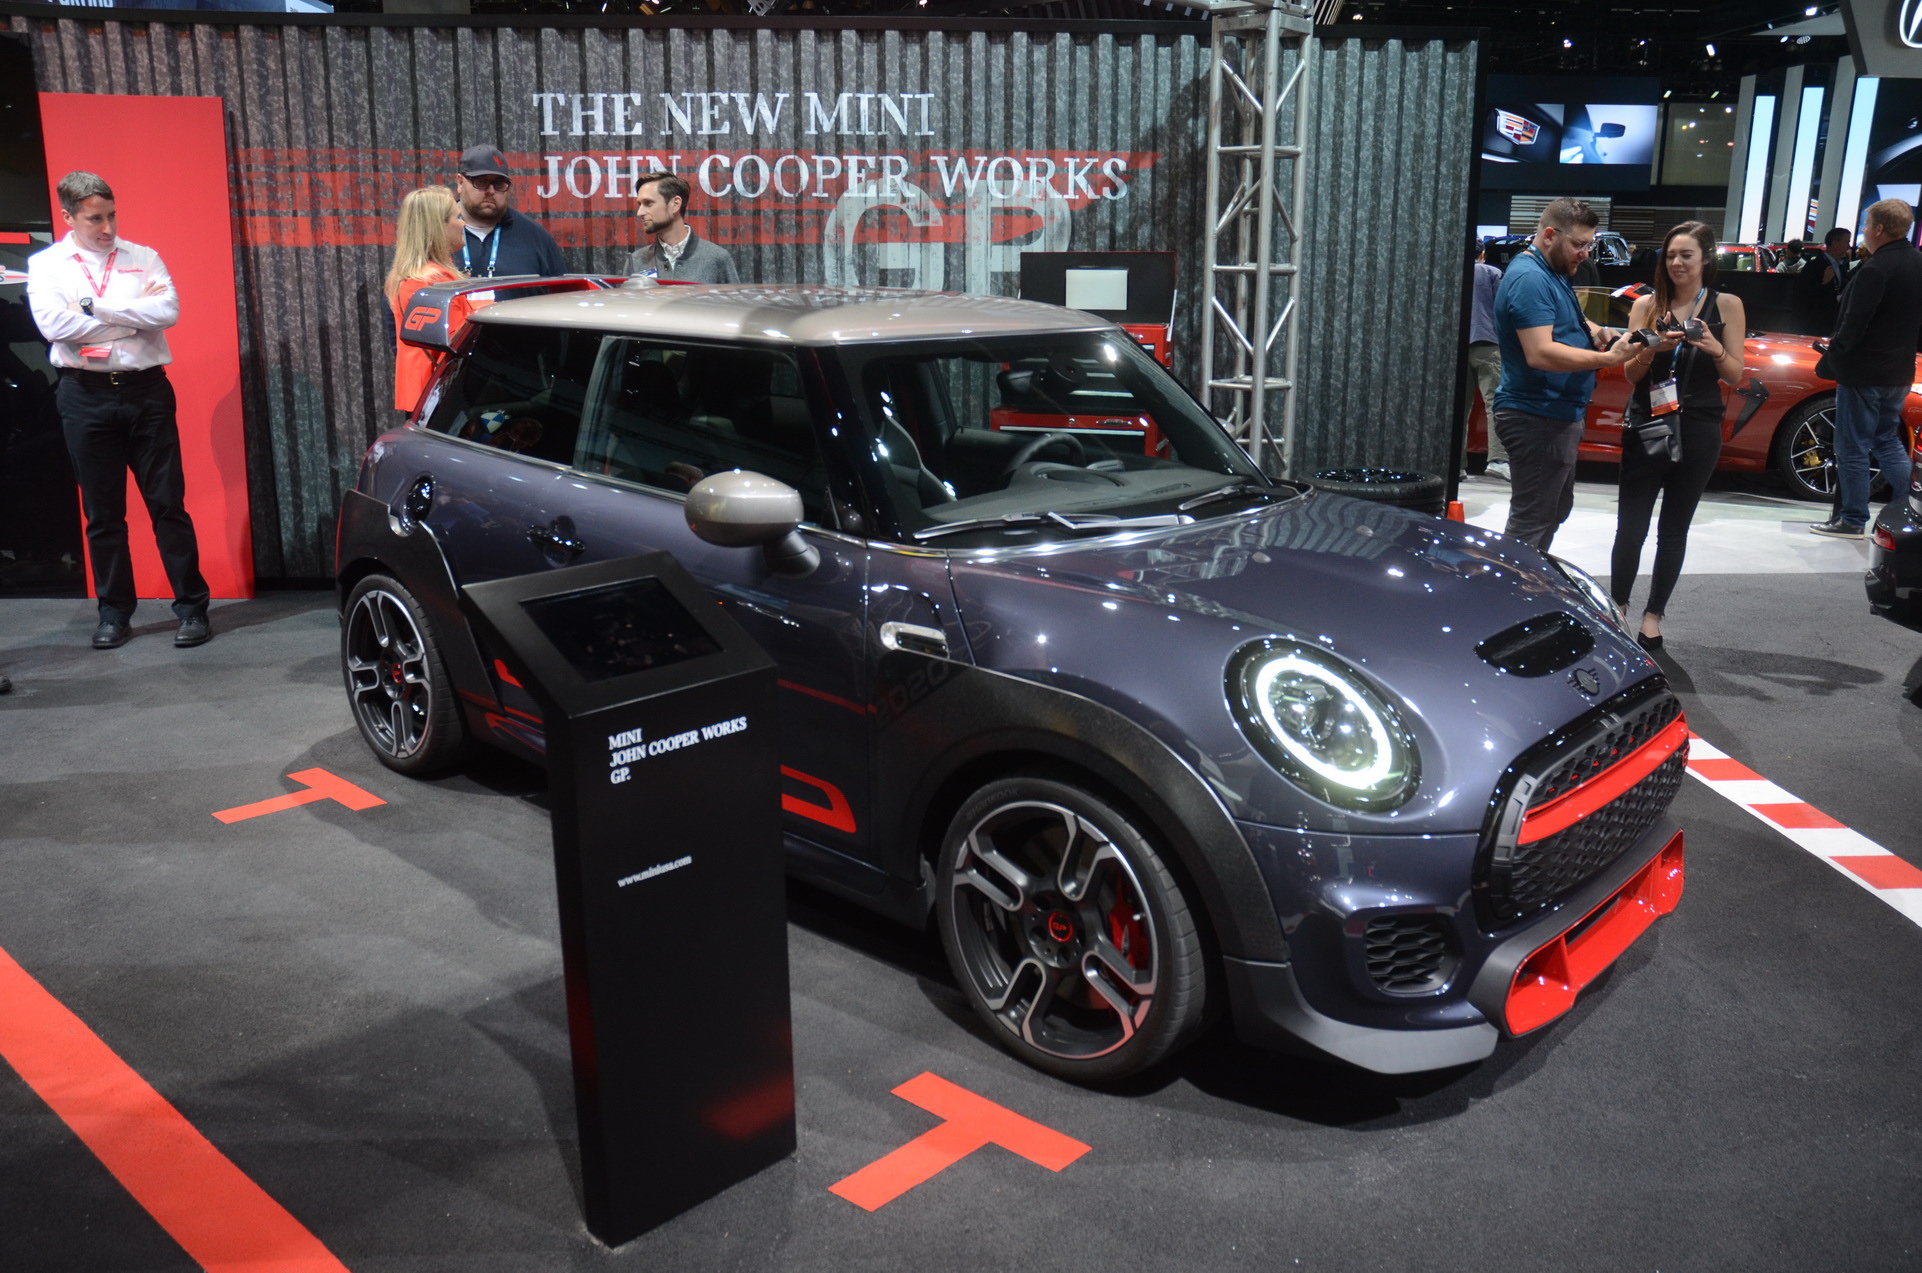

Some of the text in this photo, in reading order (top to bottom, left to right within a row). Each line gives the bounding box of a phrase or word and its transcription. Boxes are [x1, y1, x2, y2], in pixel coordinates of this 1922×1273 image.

[533, 92, 935, 136] THE NEW MINI
[699, 154, 916, 199] COOPER
[930, 155, 1130, 201] WORKS
[404, 306, 442, 332] GP
[608, 728, 643, 751] MINI
[609, 716, 748, 768] JOHN COOPER WORKS
